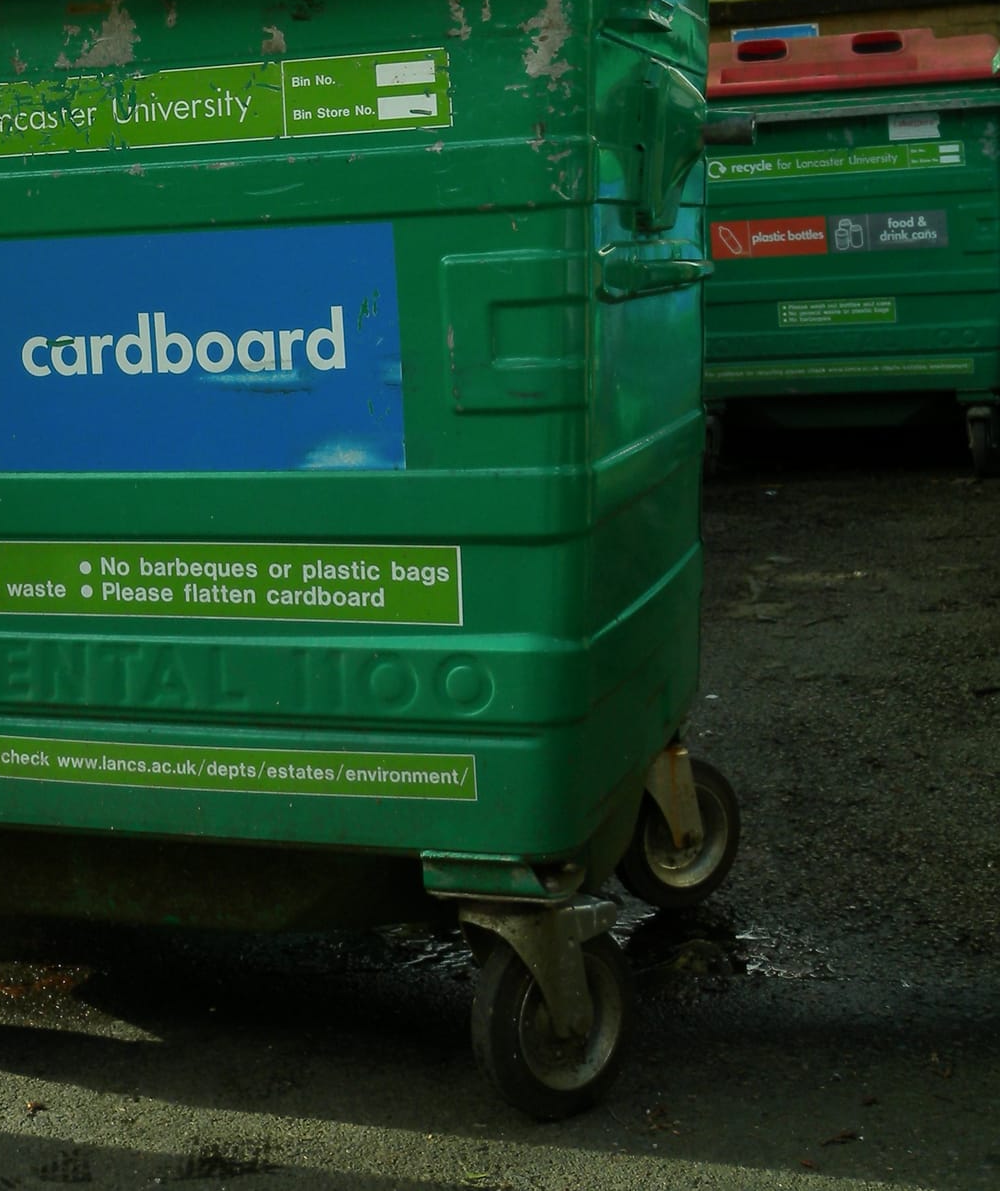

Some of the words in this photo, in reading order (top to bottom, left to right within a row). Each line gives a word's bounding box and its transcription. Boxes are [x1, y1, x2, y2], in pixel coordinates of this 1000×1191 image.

[291, 76, 312, 88] Bin
[315, 74, 336, 87] No.
[112, 87, 253, 124] University
[293, 109, 313, 121] Bin
[317, 106, 351, 120] Store
[354, 104, 376, 117] No.
[731, 159, 773, 175] recycle
[776, 159, 792, 170] for
[795, 158, 844, 170] Lancaster
[848, 152, 899, 166] University
[887, 217, 915, 229] food
[917, 216, 928, 228] &
[751, 230, 786, 245] plastic
[787, 228, 825, 242] bottles
[879, 230, 908, 242] drink
[911, 230, 937, 241] cans
[20, 305, 348, 378] cardboard
[100, 556, 131, 577] No
[139, 557, 259, 584] barbeques
[268, 563, 292, 579] or
[302, 560, 381, 583] plastic
[390, 561, 451, 586] bags
[7, 581, 67, 598] waste
[101, 582, 174, 603] Please
[183, 583, 257, 605] flatten
[265, 586, 386, 608] cardboard
[0, 750, 50, 767] check
[57, 754, 469, 787] www.lancs.ac.uk/depts/estates/environment/
